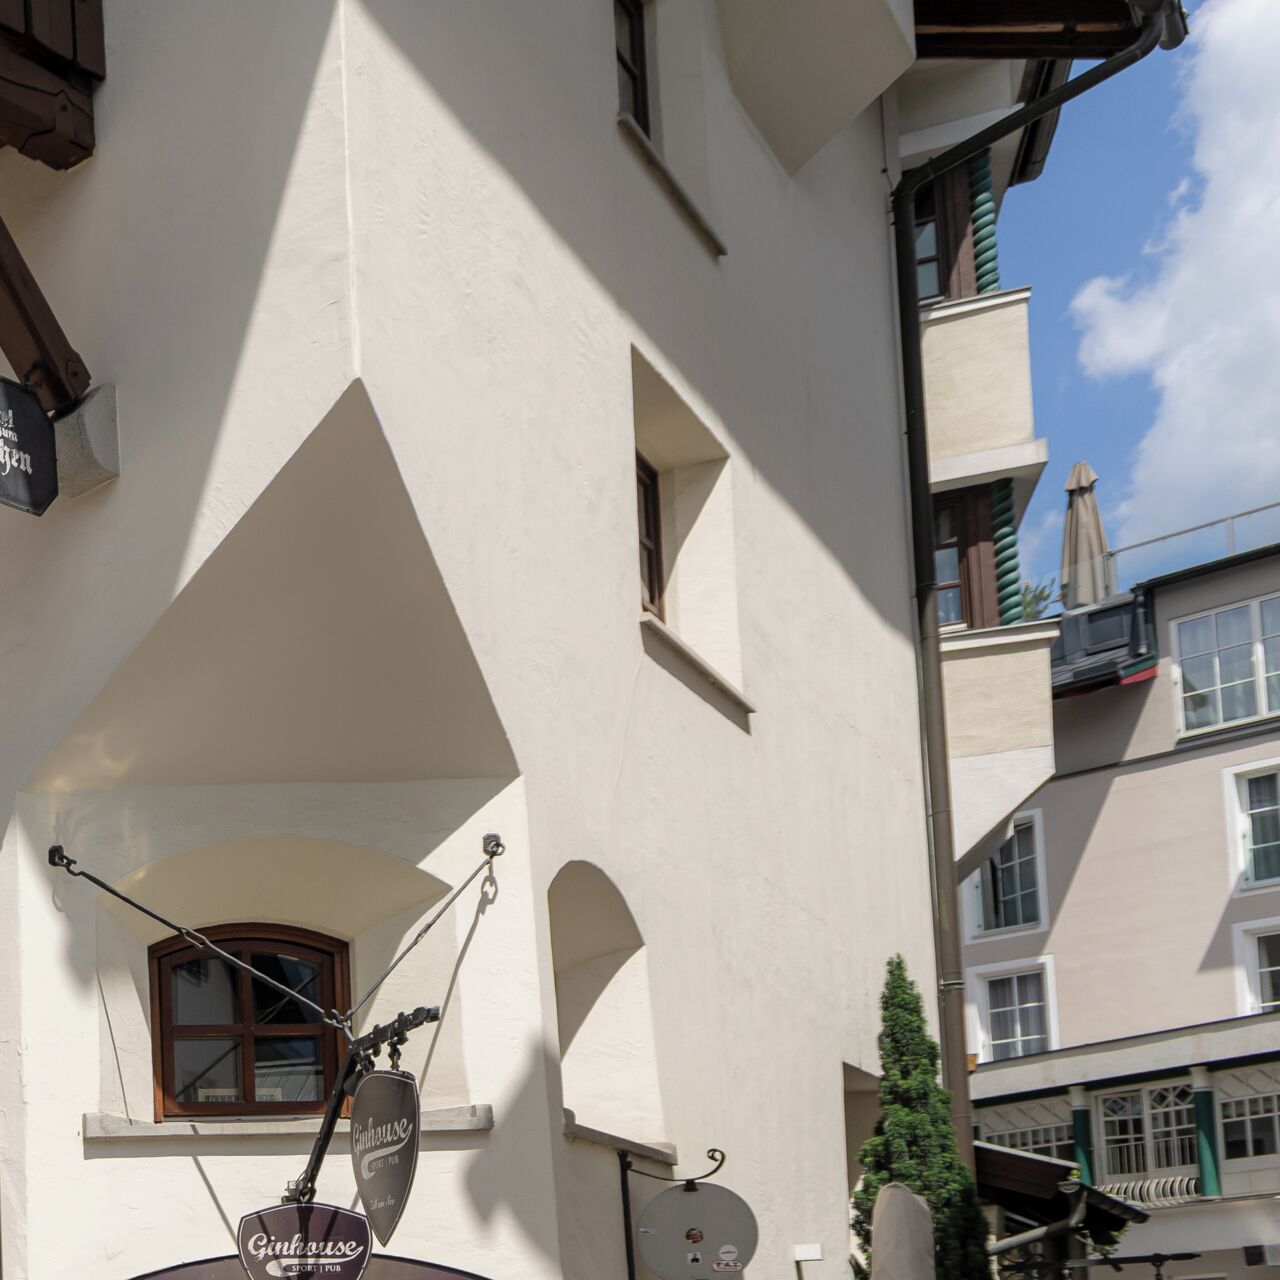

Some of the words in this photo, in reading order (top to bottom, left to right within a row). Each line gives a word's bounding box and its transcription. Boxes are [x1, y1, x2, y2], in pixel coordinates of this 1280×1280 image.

[352, 1117, 413, 1156] Ginhouse
[388, 1155, 399, 1165] PUB
[247, 1233, 364, 1262] Ginhouse
[291, 1264, 317, 1272] SPORT
[325, 1264, 341, 1272] PUB
